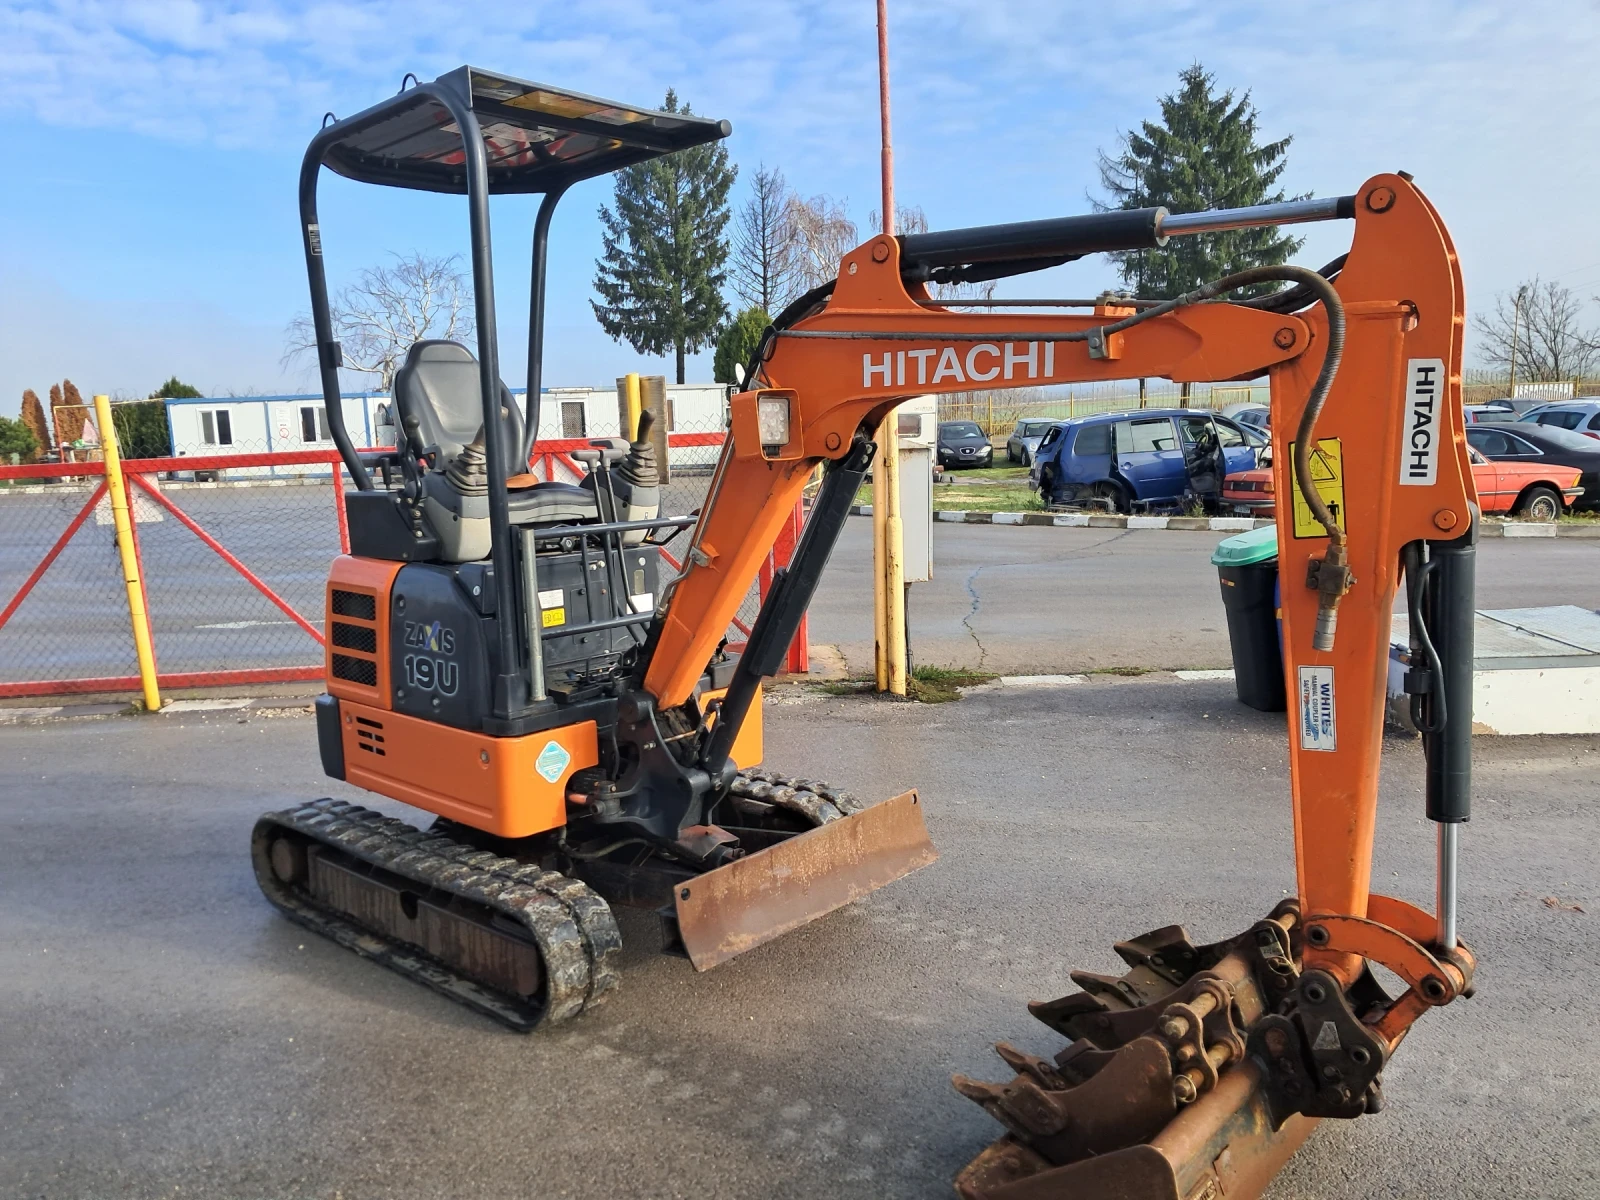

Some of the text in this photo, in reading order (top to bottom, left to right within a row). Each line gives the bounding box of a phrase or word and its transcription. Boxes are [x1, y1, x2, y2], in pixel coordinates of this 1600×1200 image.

[863, 341, 1054, 388] HITACHI
[1409, 366, 1436, 478] HITACHI
[404, 620, 455, 655] ZAXIS
[404, 654, 459, 696] 19U
